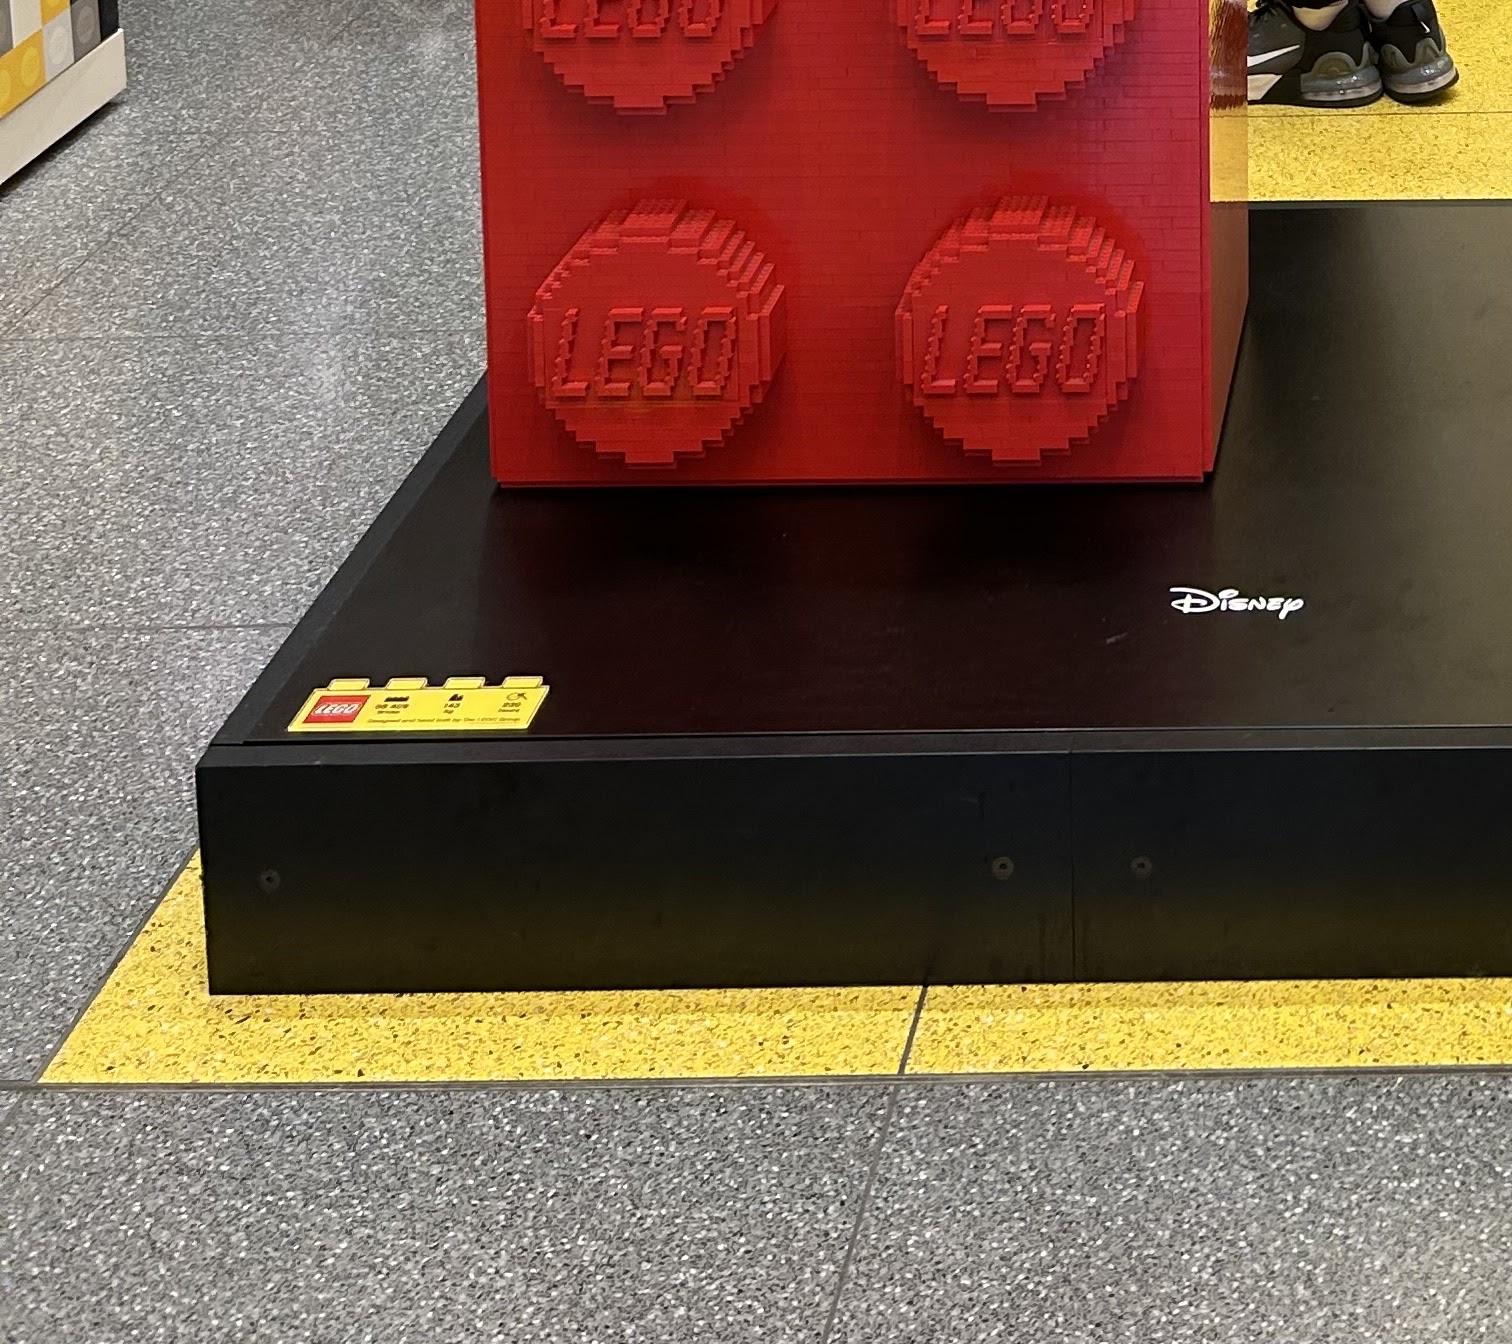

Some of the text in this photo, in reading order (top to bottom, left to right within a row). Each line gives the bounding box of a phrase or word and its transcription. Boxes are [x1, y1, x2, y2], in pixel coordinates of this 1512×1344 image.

[550, 306, 738, 400] LEGO
[920, 303, 1106, 396] LEGO
[1169, 587, 1305, 620] Disney
[313, 701, 363, 716] LEGO
